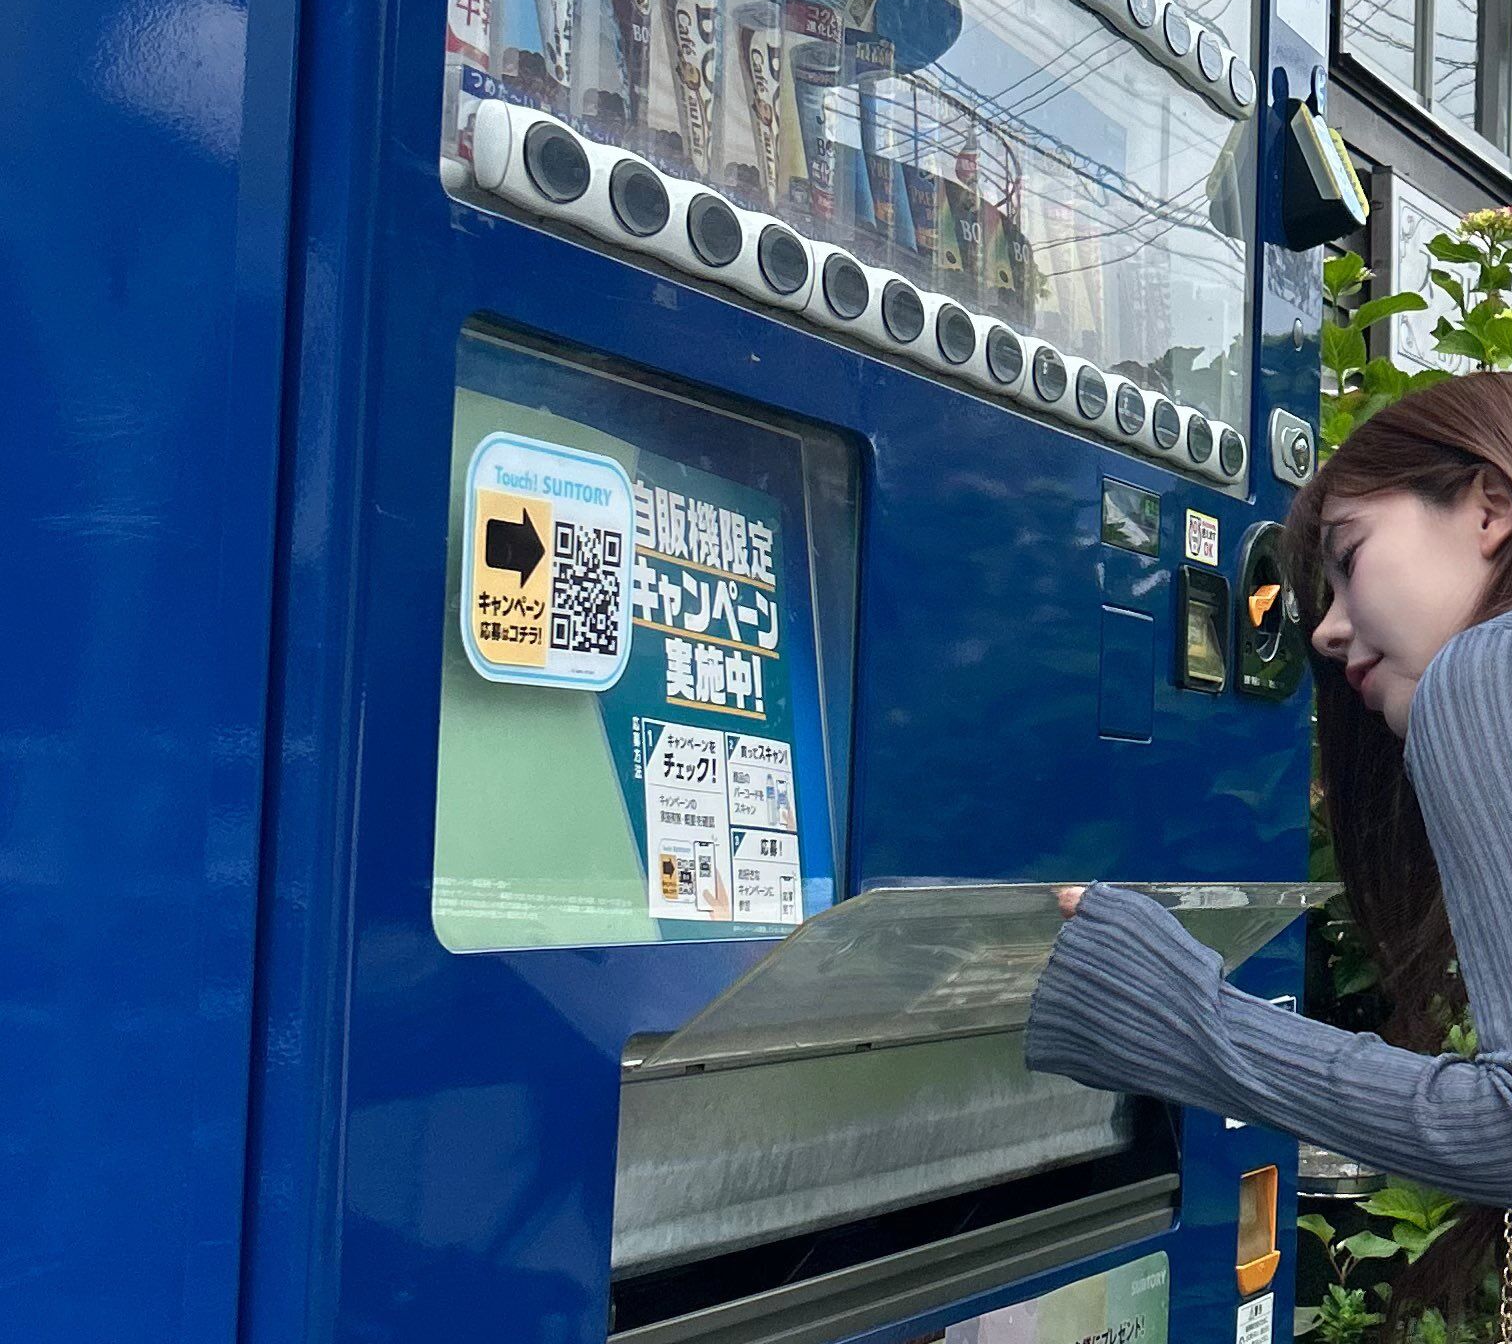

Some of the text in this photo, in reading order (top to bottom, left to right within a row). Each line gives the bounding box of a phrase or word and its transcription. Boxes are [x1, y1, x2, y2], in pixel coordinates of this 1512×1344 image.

[494, 464, 538, 492] Touch!
[632, 478, 777, 587] 自販機限定
[478, 590, 546, 621] キャンペーン
[632, 554, 779, 651] キャンペーン
[479, 621, 543, 646] 応募はコチラ!
[665, 636, 765, 713] 実施中!
[667, 733, 717, 755] キャンペーンを
[663, 752, 717, 784] チェック!
